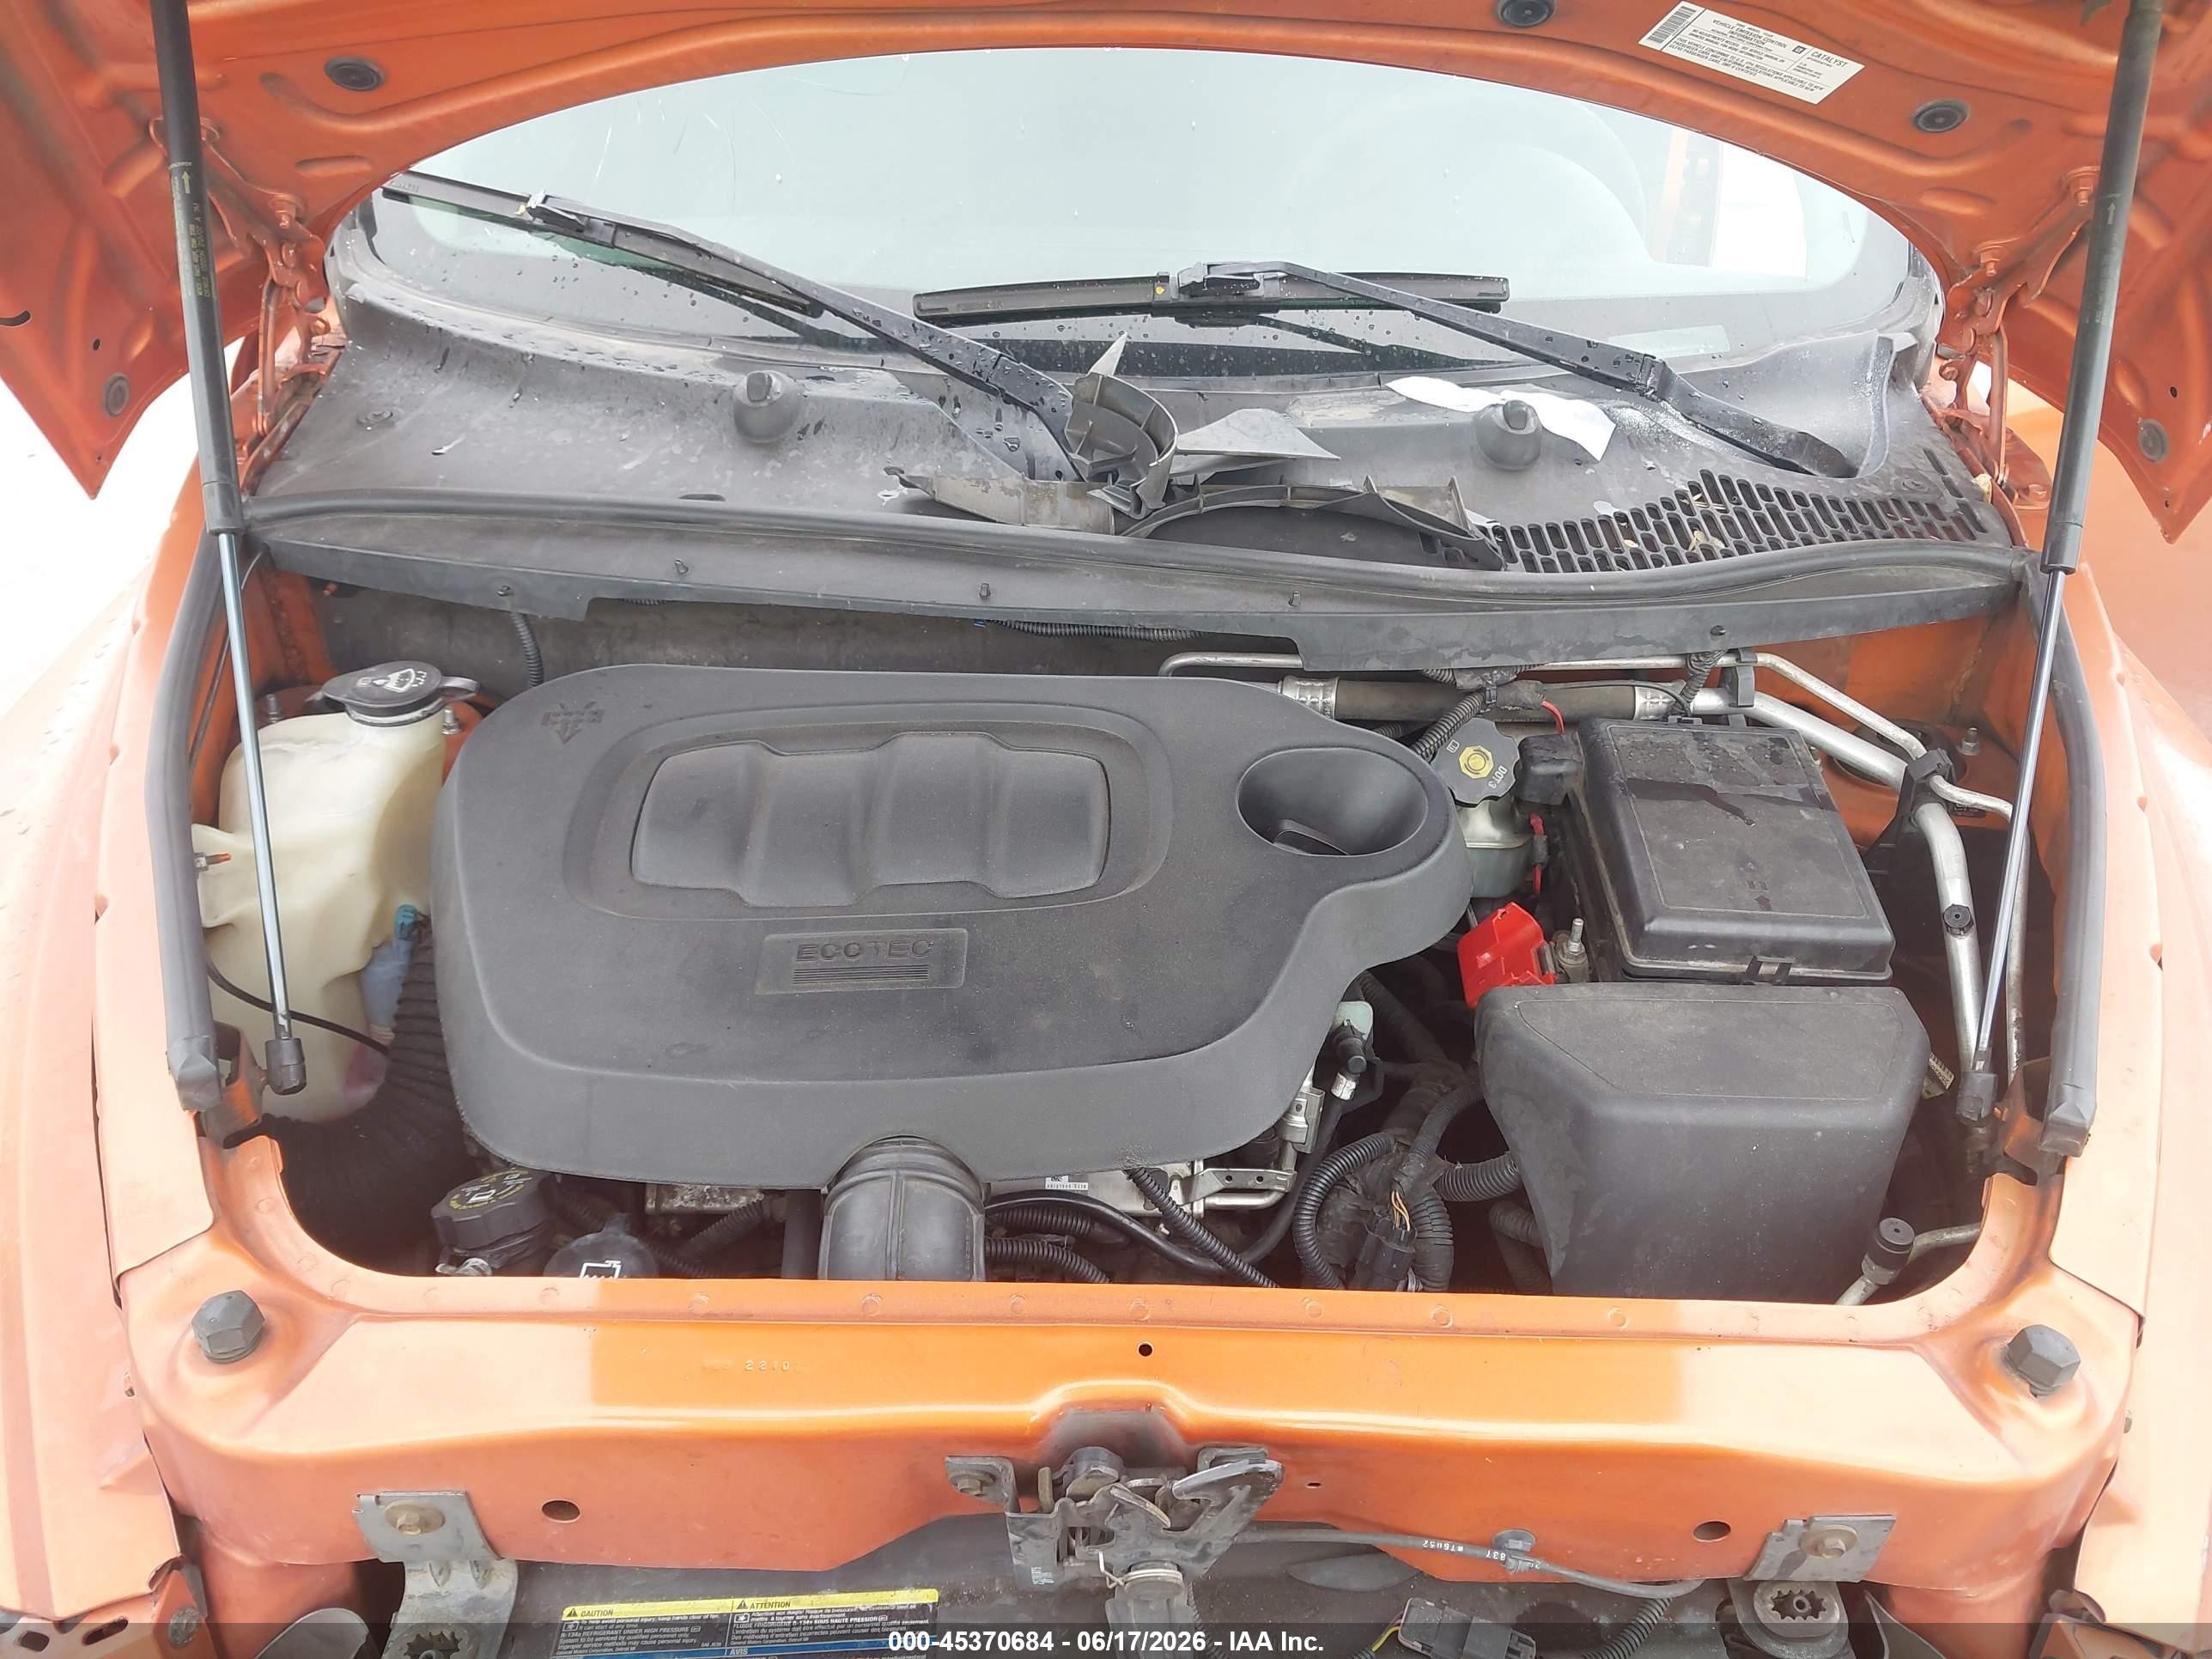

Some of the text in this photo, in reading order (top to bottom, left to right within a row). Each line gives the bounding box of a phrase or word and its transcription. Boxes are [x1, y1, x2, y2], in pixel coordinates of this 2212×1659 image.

[1711, 19, 1788, 48] VEHICLE EMISSION CONTROL
[1727, 29, 1766, 45] INFORMATION
[1672, 40, 1699, 52] PASSENGER
[1718, 57, 1746, 68] CALIFORNIA
[1743, 65, 1774, 77] REGULATIONS
[1772, 75, 1799, 86] APPLICABLE
[1686, 40, 1705, 49] VEHICLE
[1705, 46, 1730, 58] CONFORMS
[1753, 64, 1783, 76] REGULATIONS
[1781, 74, 1808, 84] APPLICABLE
[1809, 51, 1848, 67] CATALYST
[1487, 764, 1509, 789] DOT 3
[795, 939, 933, 962] ECOTEC
[1486, 1550, 1506, 1561] 837
[750, 1601, 791, 1609] ATTENTION
